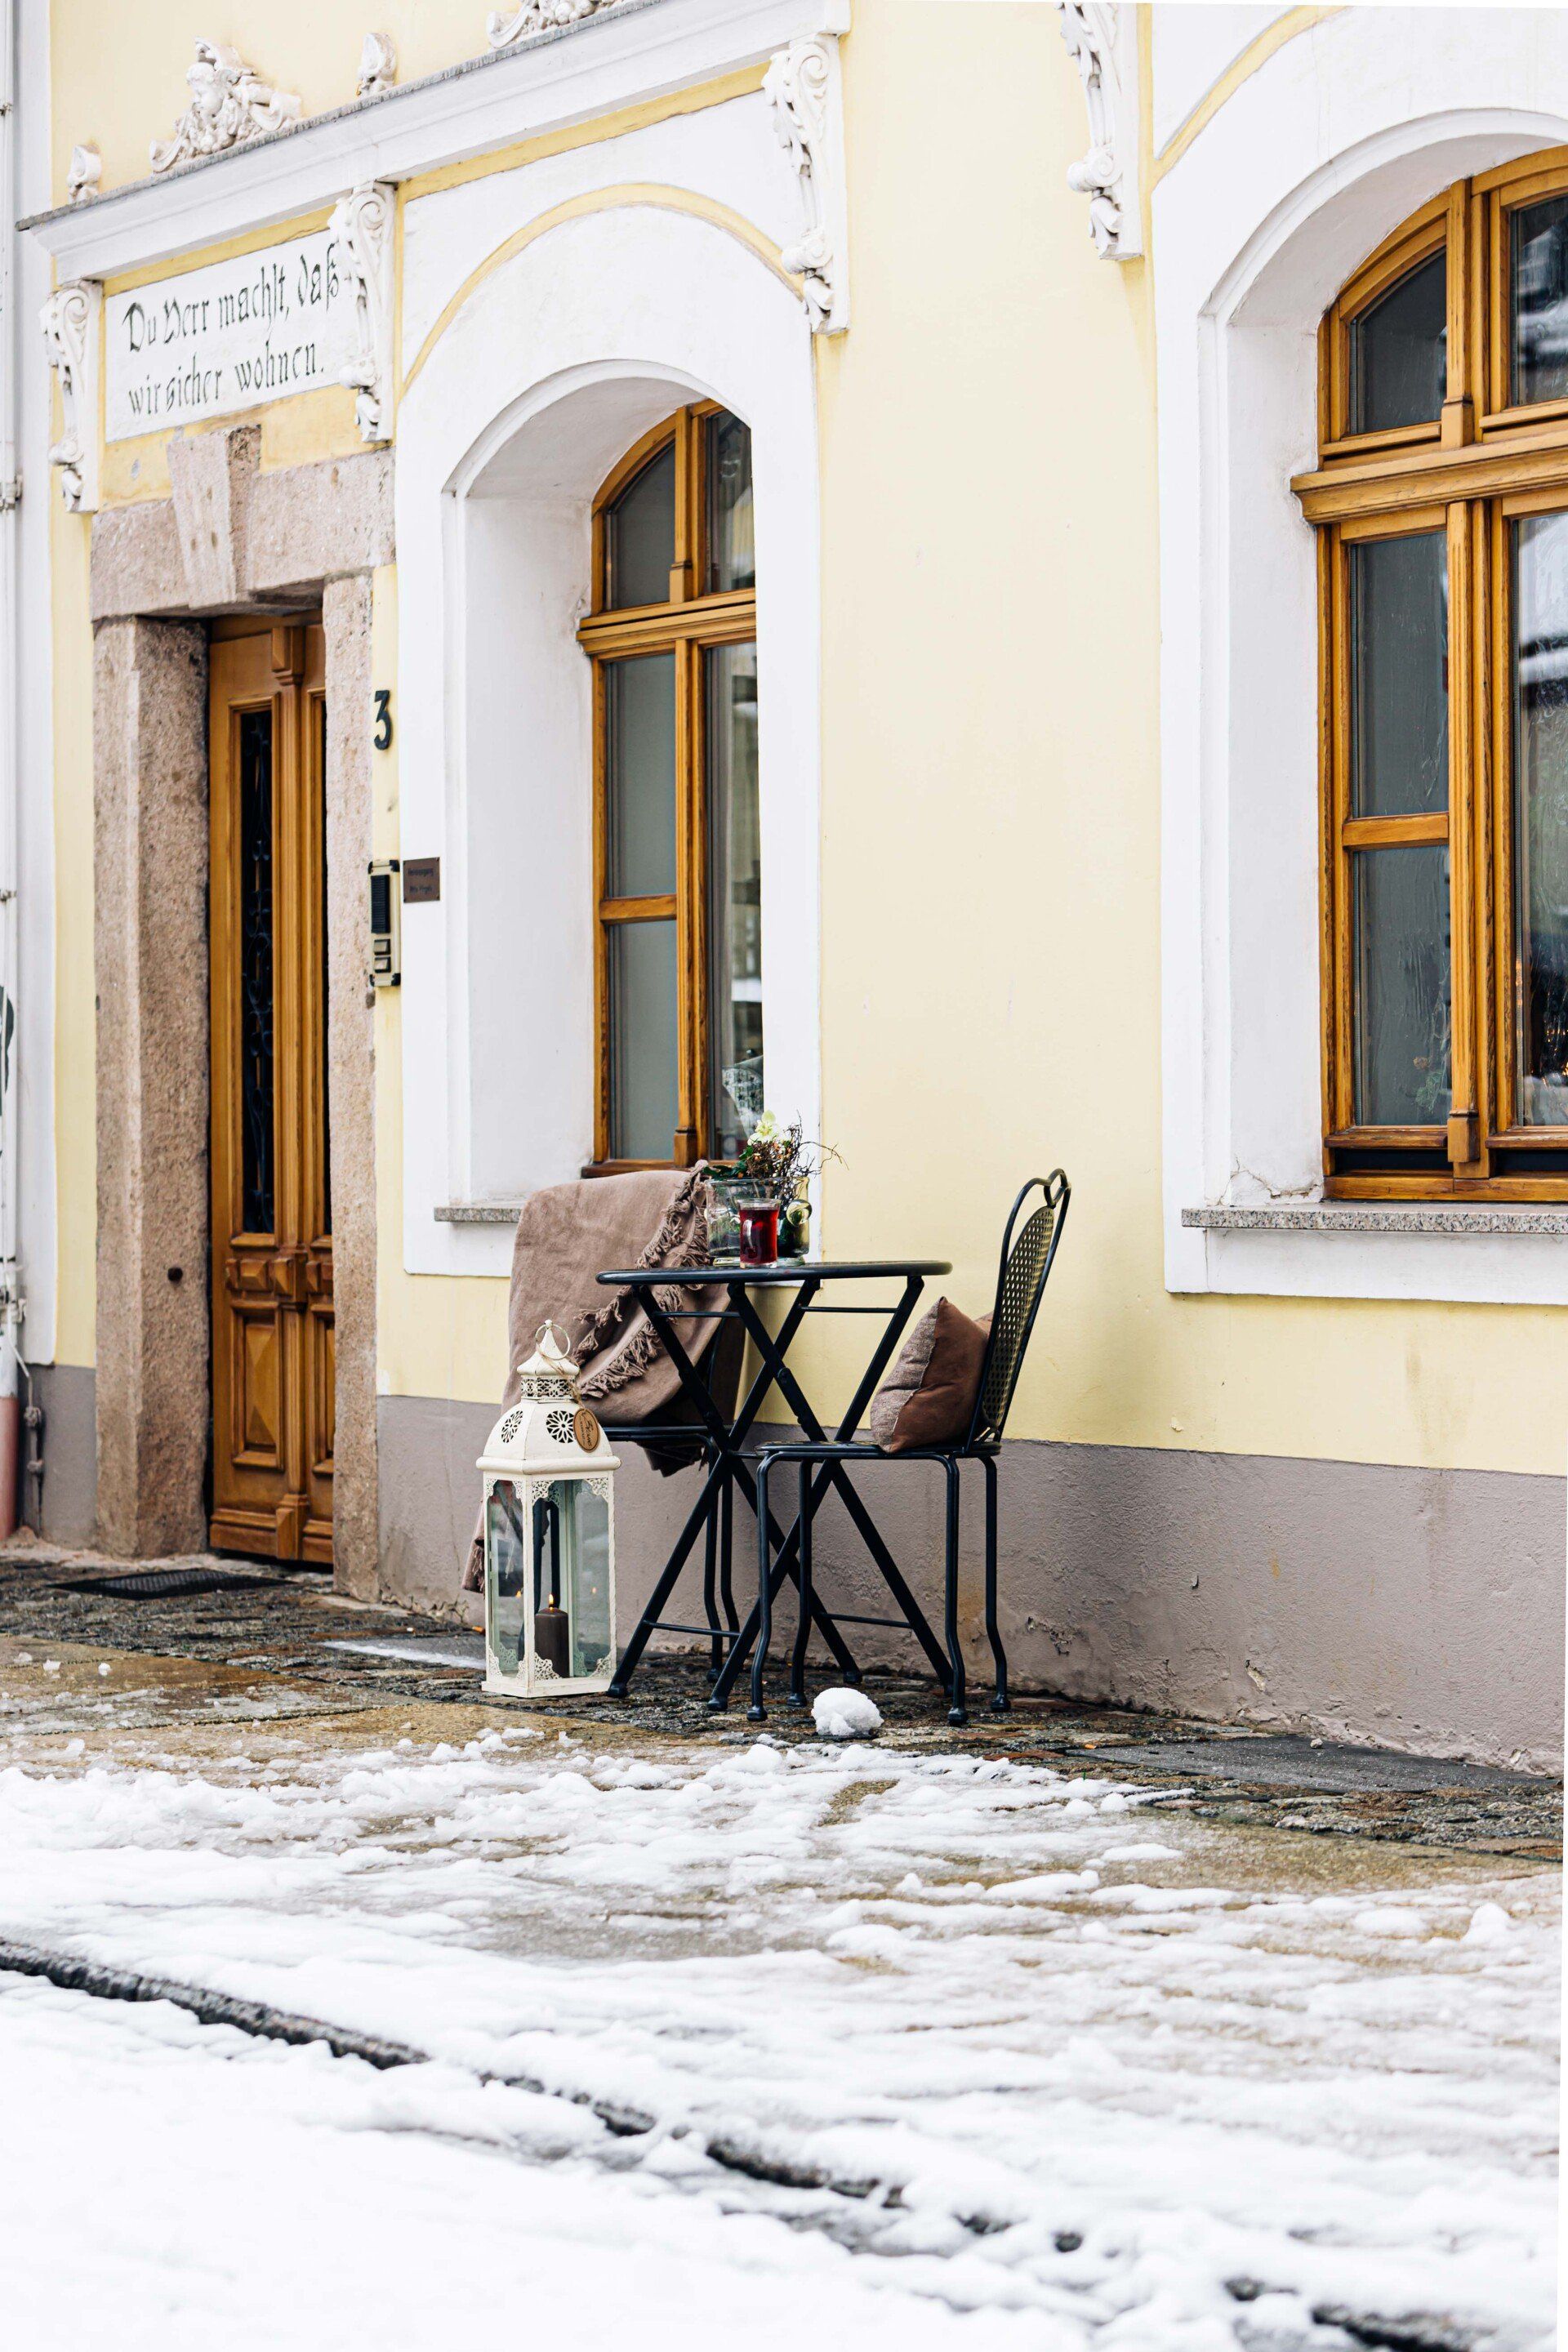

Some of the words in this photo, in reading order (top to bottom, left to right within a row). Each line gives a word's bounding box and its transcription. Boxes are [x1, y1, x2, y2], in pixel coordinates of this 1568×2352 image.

[122, 302, 156, 352] Du
[129, 374, 161, 415] wir
[166, 352, 221, 412] sicher
[234, 336, 323, 392] wohnen.
[374, 689, 392, 751] 3
